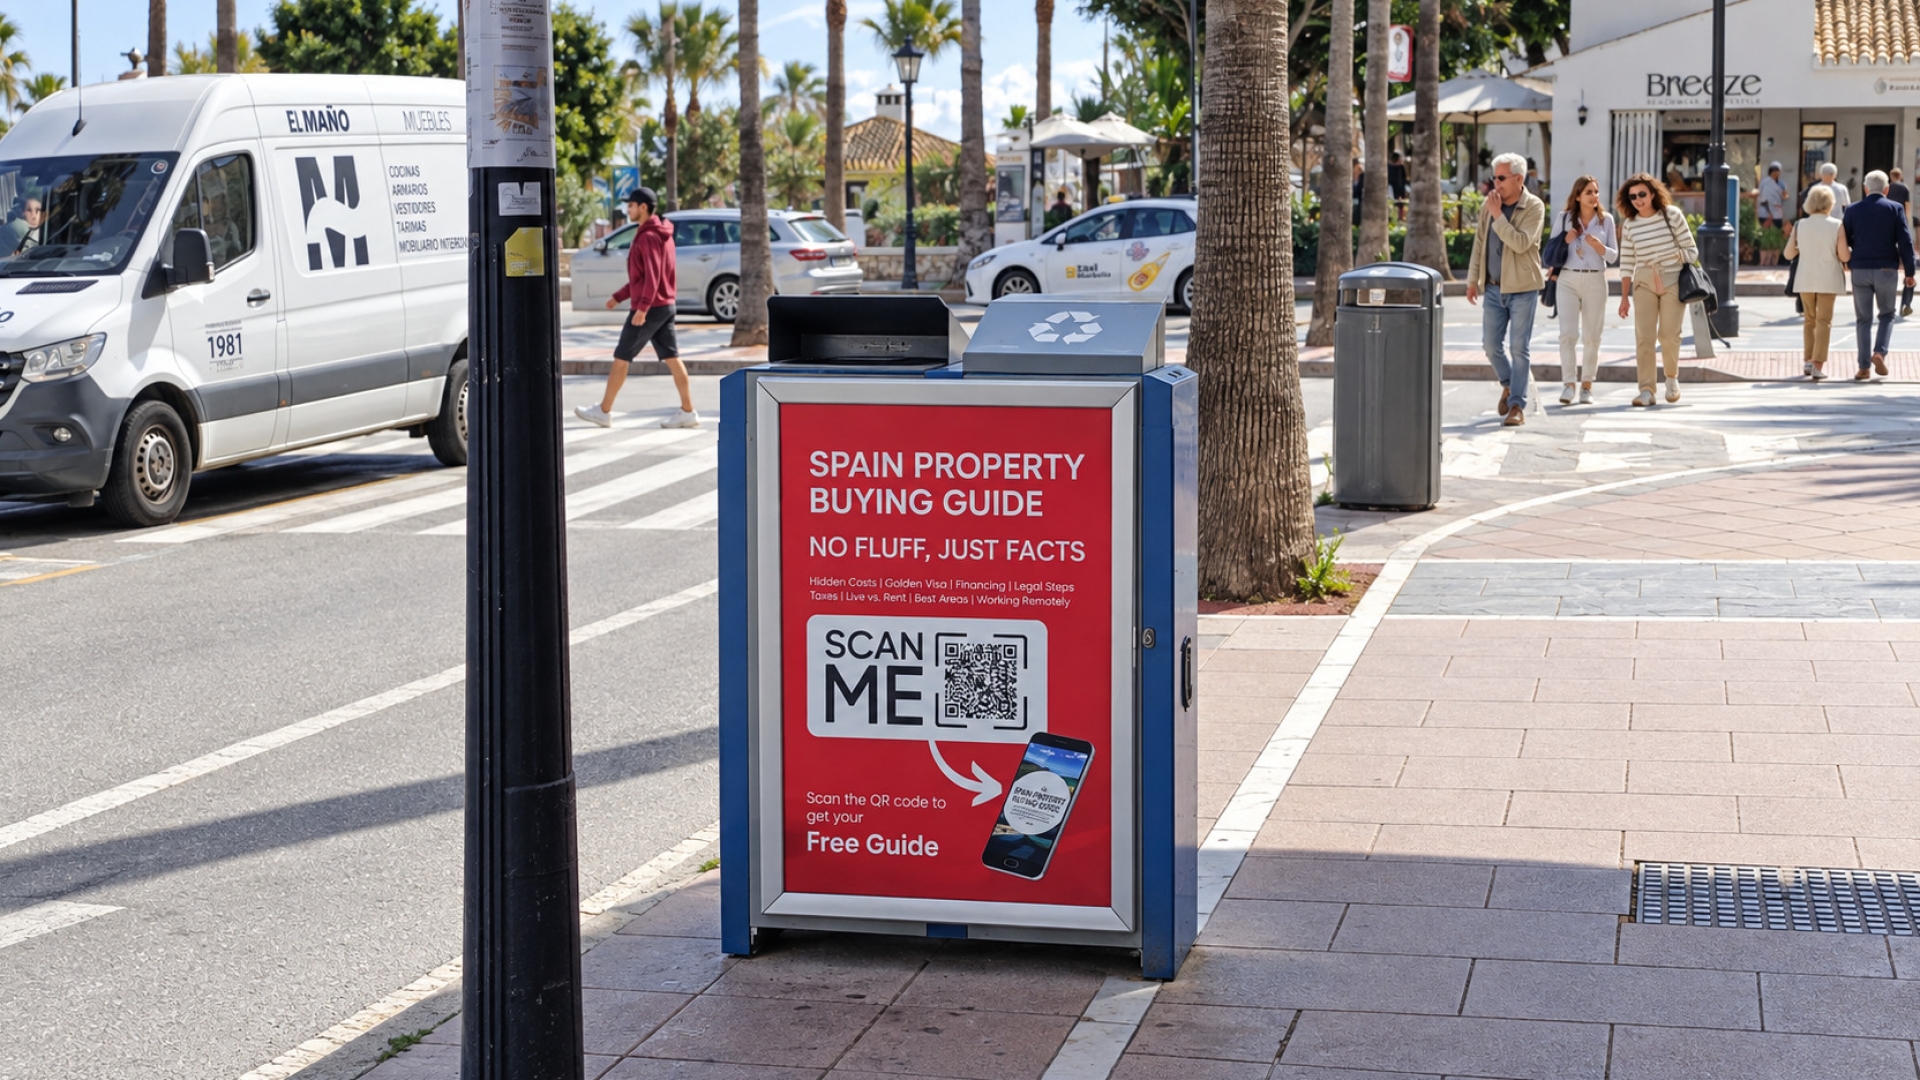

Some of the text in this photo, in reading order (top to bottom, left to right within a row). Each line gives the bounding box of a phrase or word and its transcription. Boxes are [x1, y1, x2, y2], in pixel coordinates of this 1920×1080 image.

[286, 105, 350, 133] EL MAÑO
[402, 111, 452, 131] MUEBLES
[392, 183, 428, 196] ARMARIOS
[394, 201, 436, 215] VESTIDORES
[207, 332, 242, 358] 1981
[809, 450, 1085, 480] SPAIN PROPERTY
[810, 487, 1043, 517] BUYING GUIDE
[809, 536, 1086, 563] NO FLUFF, JUST FACTS
[809, 577, 846, 587] Hidden
[848, 577, 877, 587] Costs
[885, 578, 923, 588] Golden
[925, 579, 947, 589] Visa
[955, 580, 1006, 593] Financing
[1014, 581, 1043, 594] Legal
[1045, 582, 1075, 594] Steps
[810, 590, 838, 601] Taxes
[846, 592, 865, 602] Live
[867, 593, 881, 602] vs.
[883, 592, 907, 603] Rent
[914, 593, 936, 603] Best
[938, 594, 968, 604] Areas
[976, 595, 1020, 608] Working
[1022, 596, 1071, 609] Remotely
[825, 629, 923, 660] SCAN
[825, 664, 923, 726] ME
[806, 791, 947, 809] Scan the QR code to
[806, 811, 864, 826] get your
[807, 831, 939, 857] Free Guide
